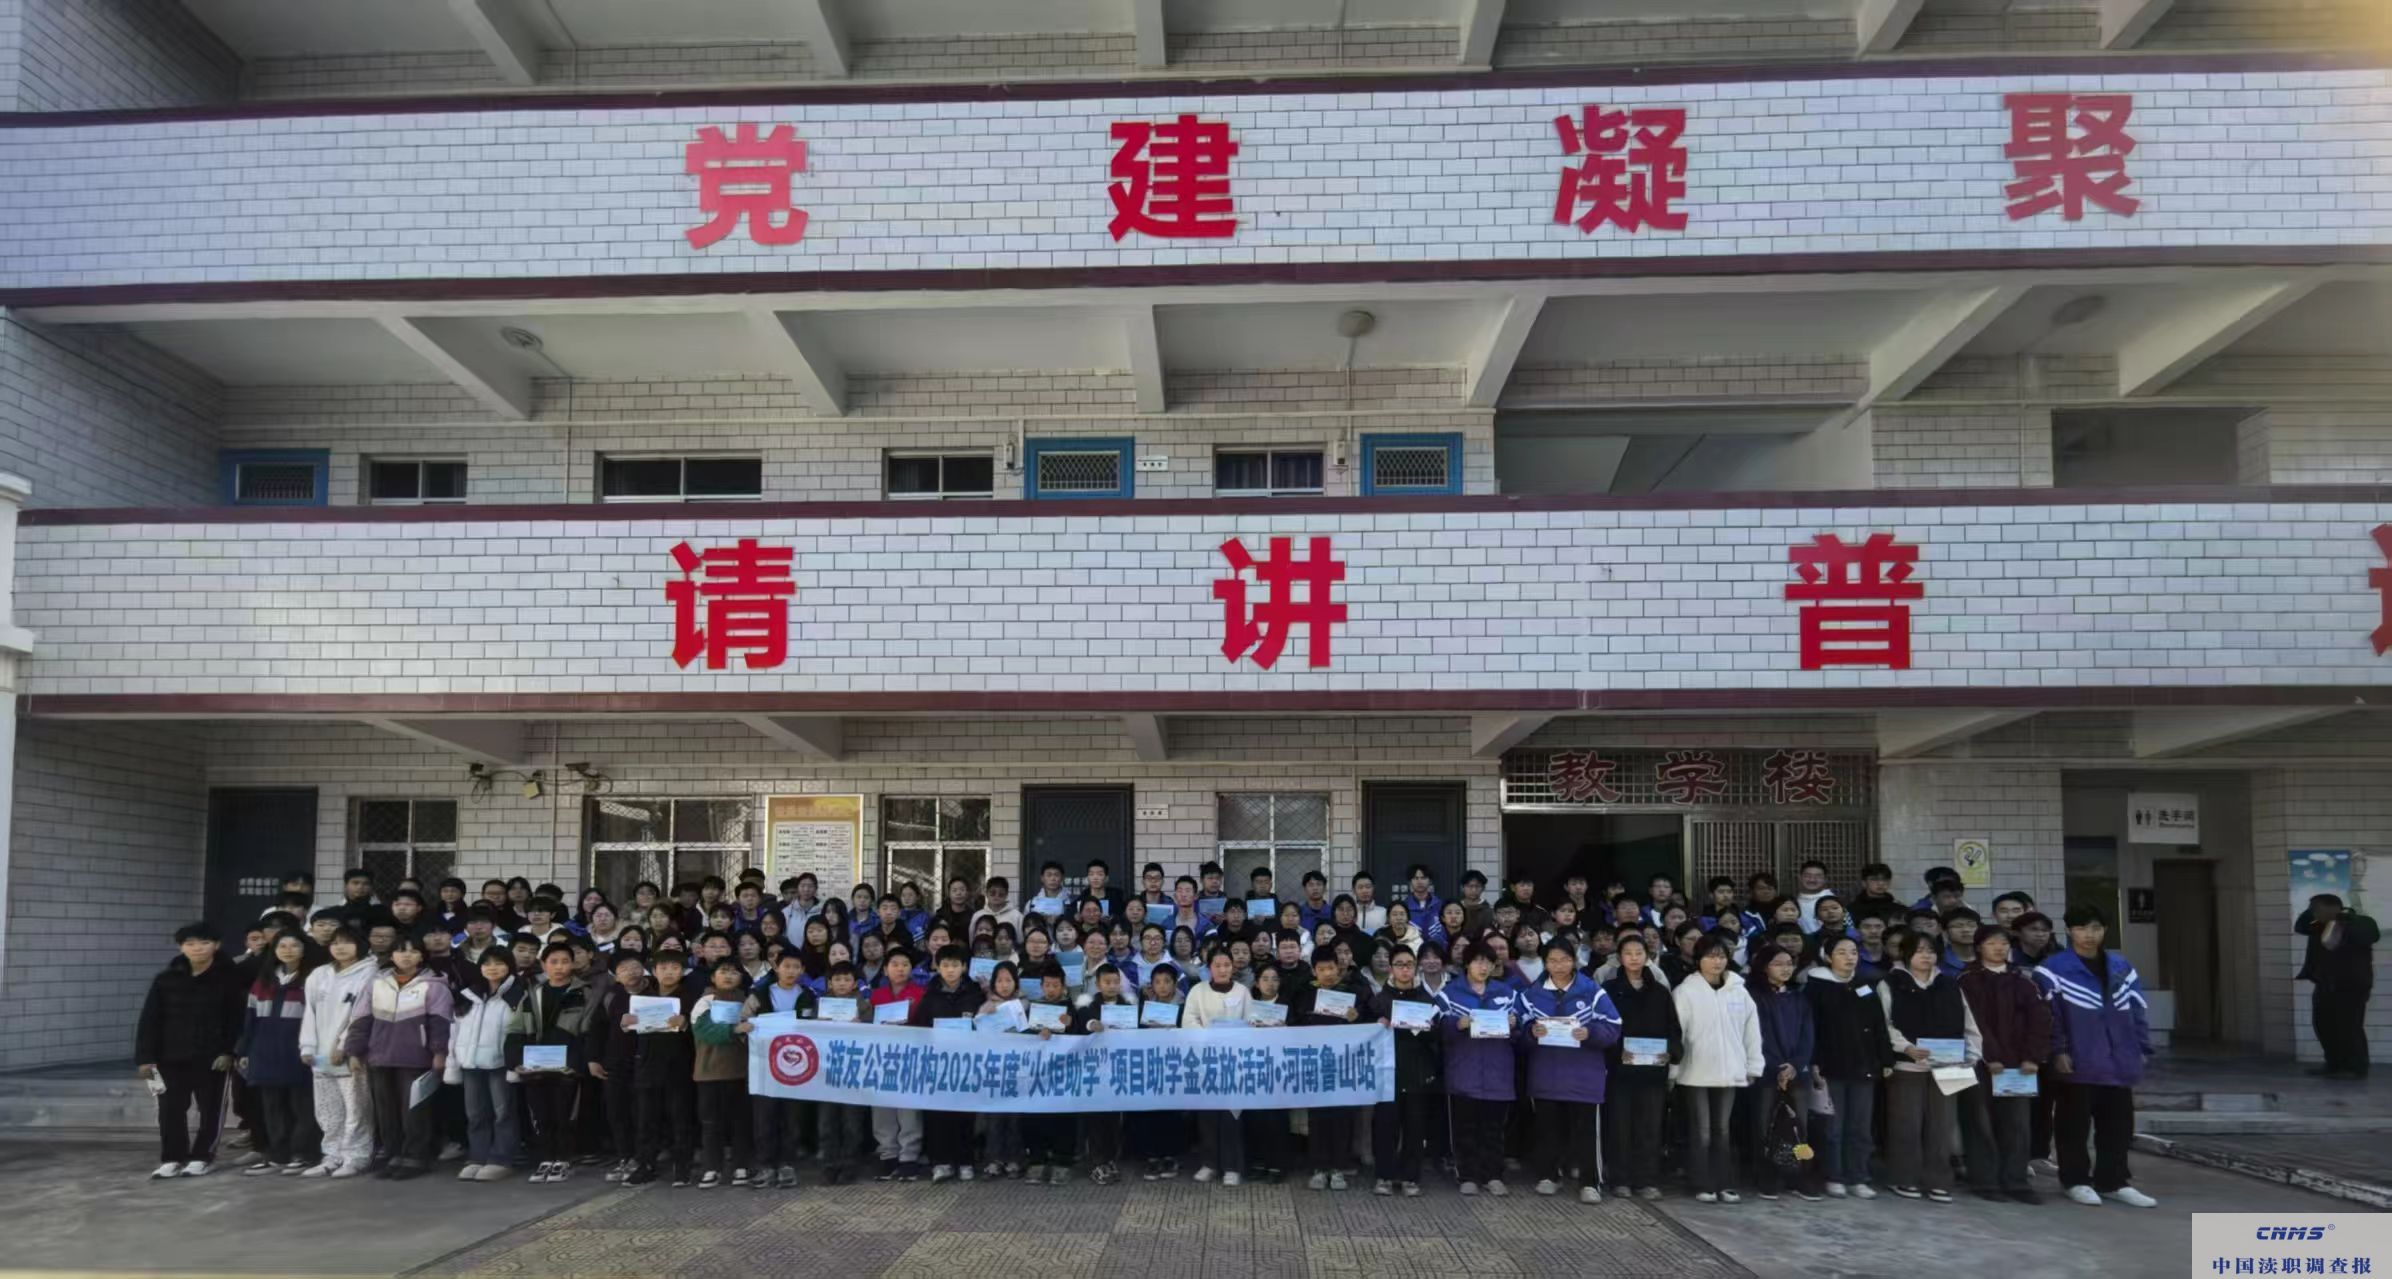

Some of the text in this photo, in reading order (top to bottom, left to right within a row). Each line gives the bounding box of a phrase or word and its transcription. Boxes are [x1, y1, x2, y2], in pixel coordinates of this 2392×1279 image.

[665, 526, 2392, 671] 请讲普
[1549, 749, 1837, 806] 教学楼
